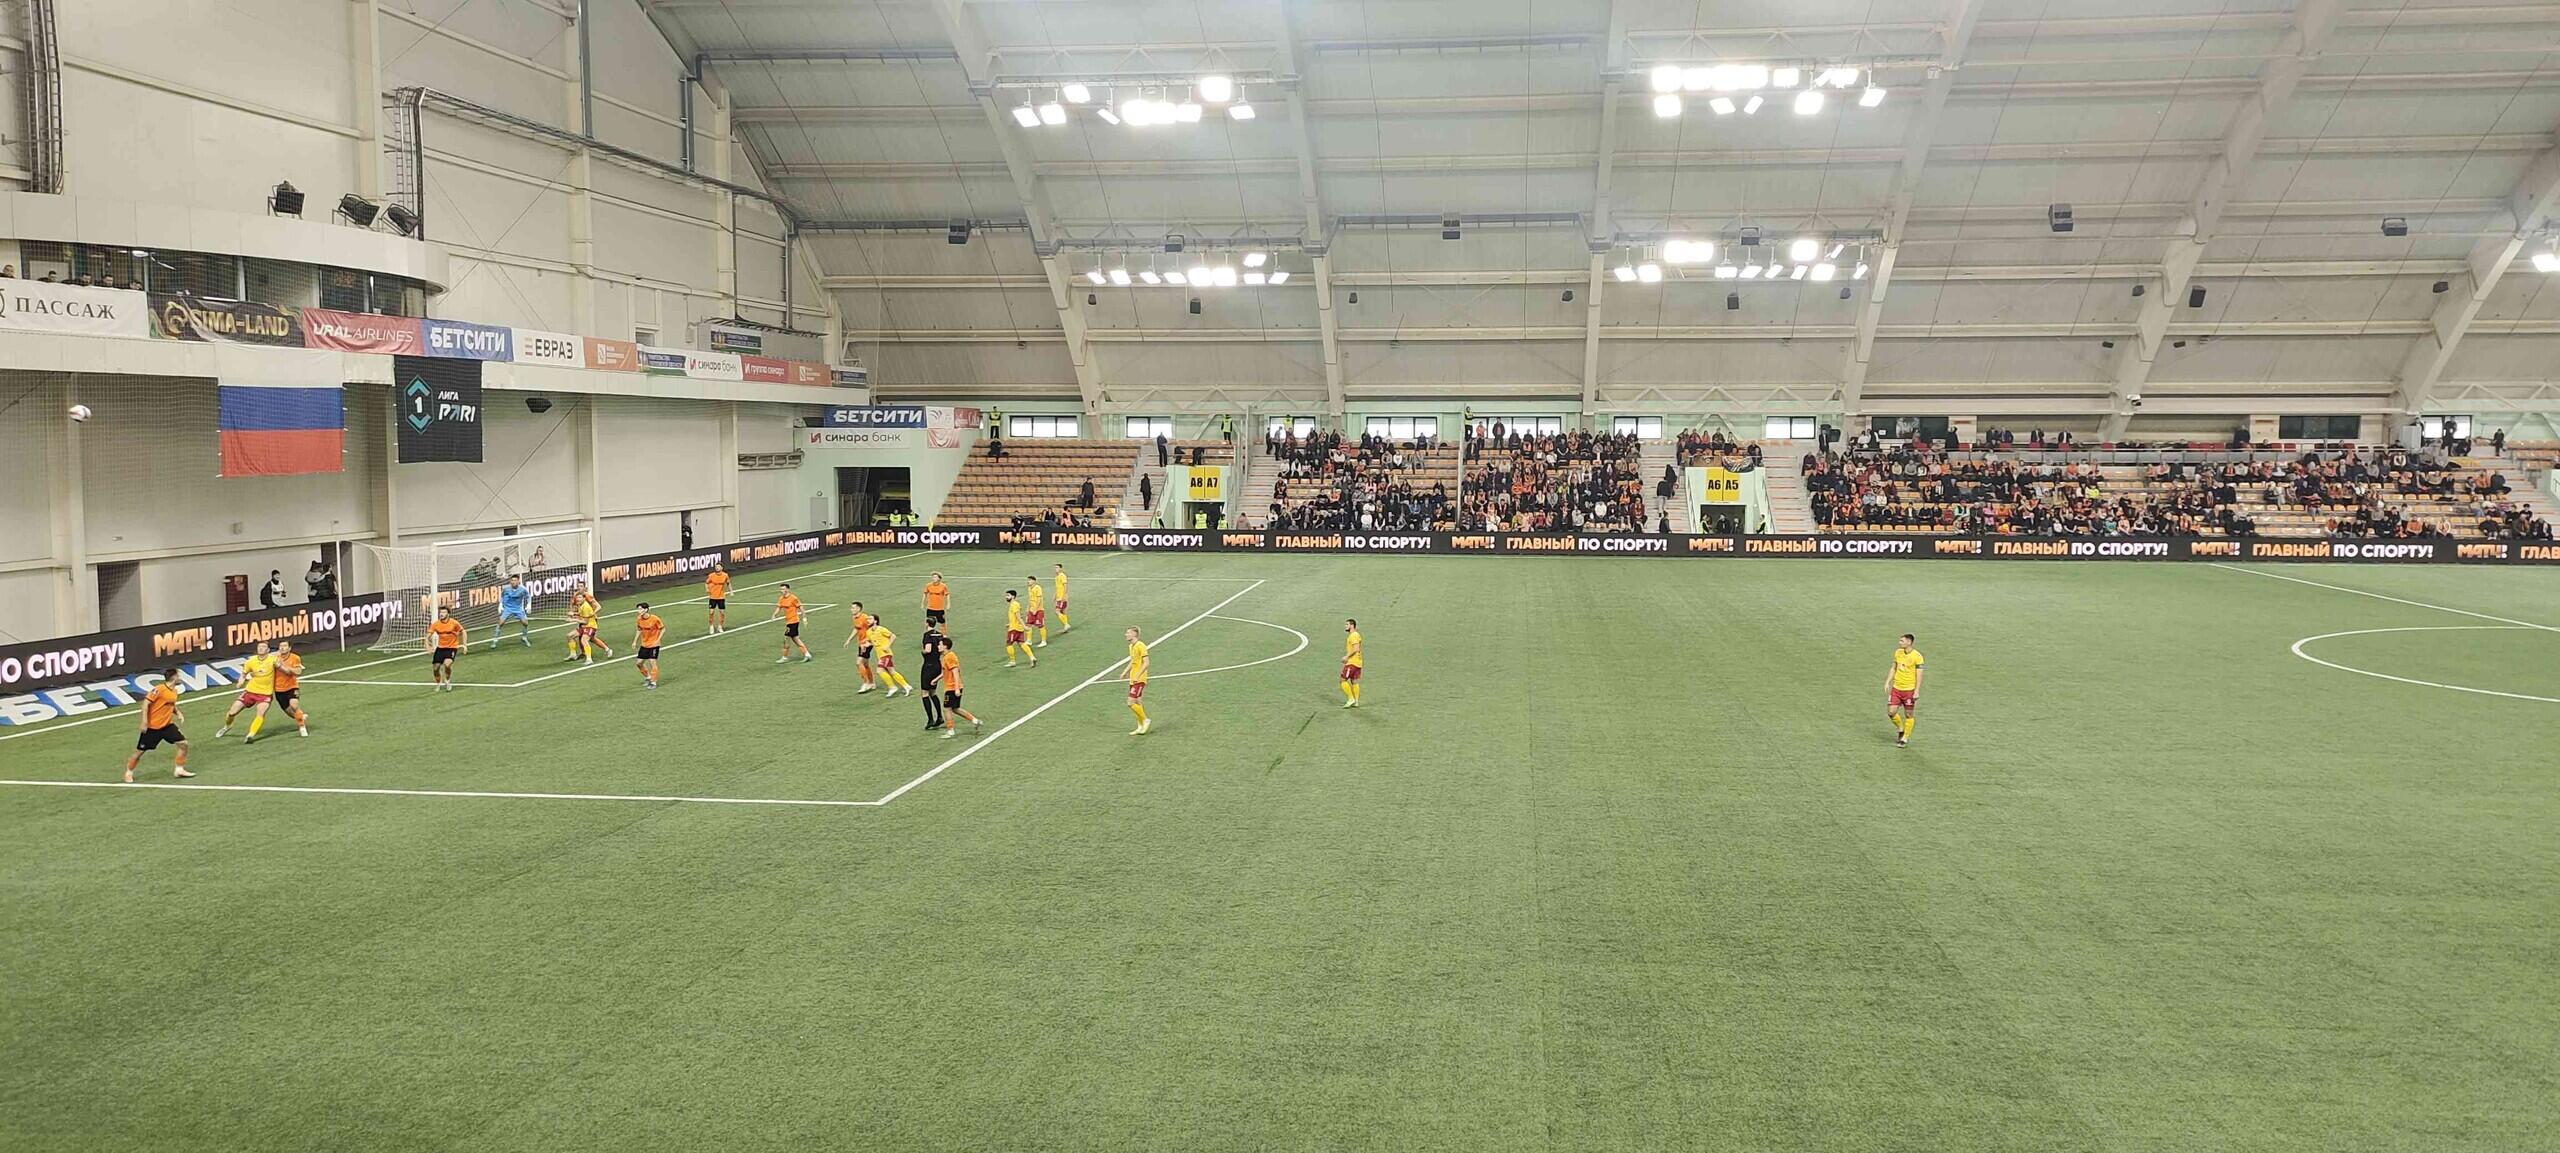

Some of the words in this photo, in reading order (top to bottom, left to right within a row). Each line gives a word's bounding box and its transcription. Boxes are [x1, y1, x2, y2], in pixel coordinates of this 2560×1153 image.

[15, 297, 115, 319] ПАССАЖ
[190, 309, 290, 337] SIMA-LAND
[313, 323, 352, 338] URAL
[352, 328, 414, 342] AIRLINES
[430, 327, 505, 352] БЕТСИТИ
[536, 338, 573, 360] ЕВРАЗ
[438, 390, 459, 401] ЛИГА
[833, 410, 924, 423] БЕТСИТИ
[825, 432, 869, 444] синара
[872, 431, 902, 442] банк
[898, 532, 918, 544] ПО
[920, 532, 979, 544] СПОРТУ!
[999, 531, 1041, 544] МТЧ!
[1051, 531, 1117, 545] ГЛАВНЫЙ
[1120, 533, 1140, 546] ПО
[1143, 533, 1202, 547] СПОРТУ!
[1222, 534, 1264, 547] МАТЧ!
[1275, 533, 1342, 548] ГЛАВНЫЙ
[1344, 536, 1365, 549] ПО
[1369, 536, 1431, 549] СПОРТУ!
[1451, 535, 1495, 549] МАТЧ!
[1506, 534, 1575, 550] ГЛАВНЫЙ
[1578, 537, 1599, 550] ПО
[1603, 537, 1668, 551] СПОРТУ!
[1689, 538, 1734, 551] МАТЧ!
[1745, 537, 1817, 552] ГЛАВНЫЙ
[1820, 540, 1842, 553] ПО
[1846, 540, 1912, 553] СПОРТУ!
[784, 541, 795, 554] ПО
[1935, 540, 1981, 553] МАТЧ!
[1994, 540, 2068, 555] ГЛАВНЫЙ
[2071, 542, 2095, 555] ПО
[2098, 542, 2168, 556] СПОРТУ!
[2191, 542, 2240, 556] МАТЧ!
[2253, 541, 2330, 557] ГЛАВНЫЙ
[2333, 544, 2358, 558] ПО
[2361, 544, 2433, 558] СПОРТУ!
[2457, 544, 2508, 558] МАТЧ!
[635, 556, 675, 579] ГЛАВНЫЙ
[675, 557, 688, 573] ПО
[689, 553, 722, 571] СПОРТУ!
[422, 590, 460, 610] МТЧ!
[153, 626, 214, 658] МАТЧ!
[227, 609, 309, 646] ГЛАВНЫЙ
[312, 610, 337, 633] ПО
[341, 600, 403, 628] СПОРТУ!
[0, 657, 22, 684] О
[27, 642, 125, 679] СПОРТУ!
[0, 655, 258, 726] БЕТСИТ
